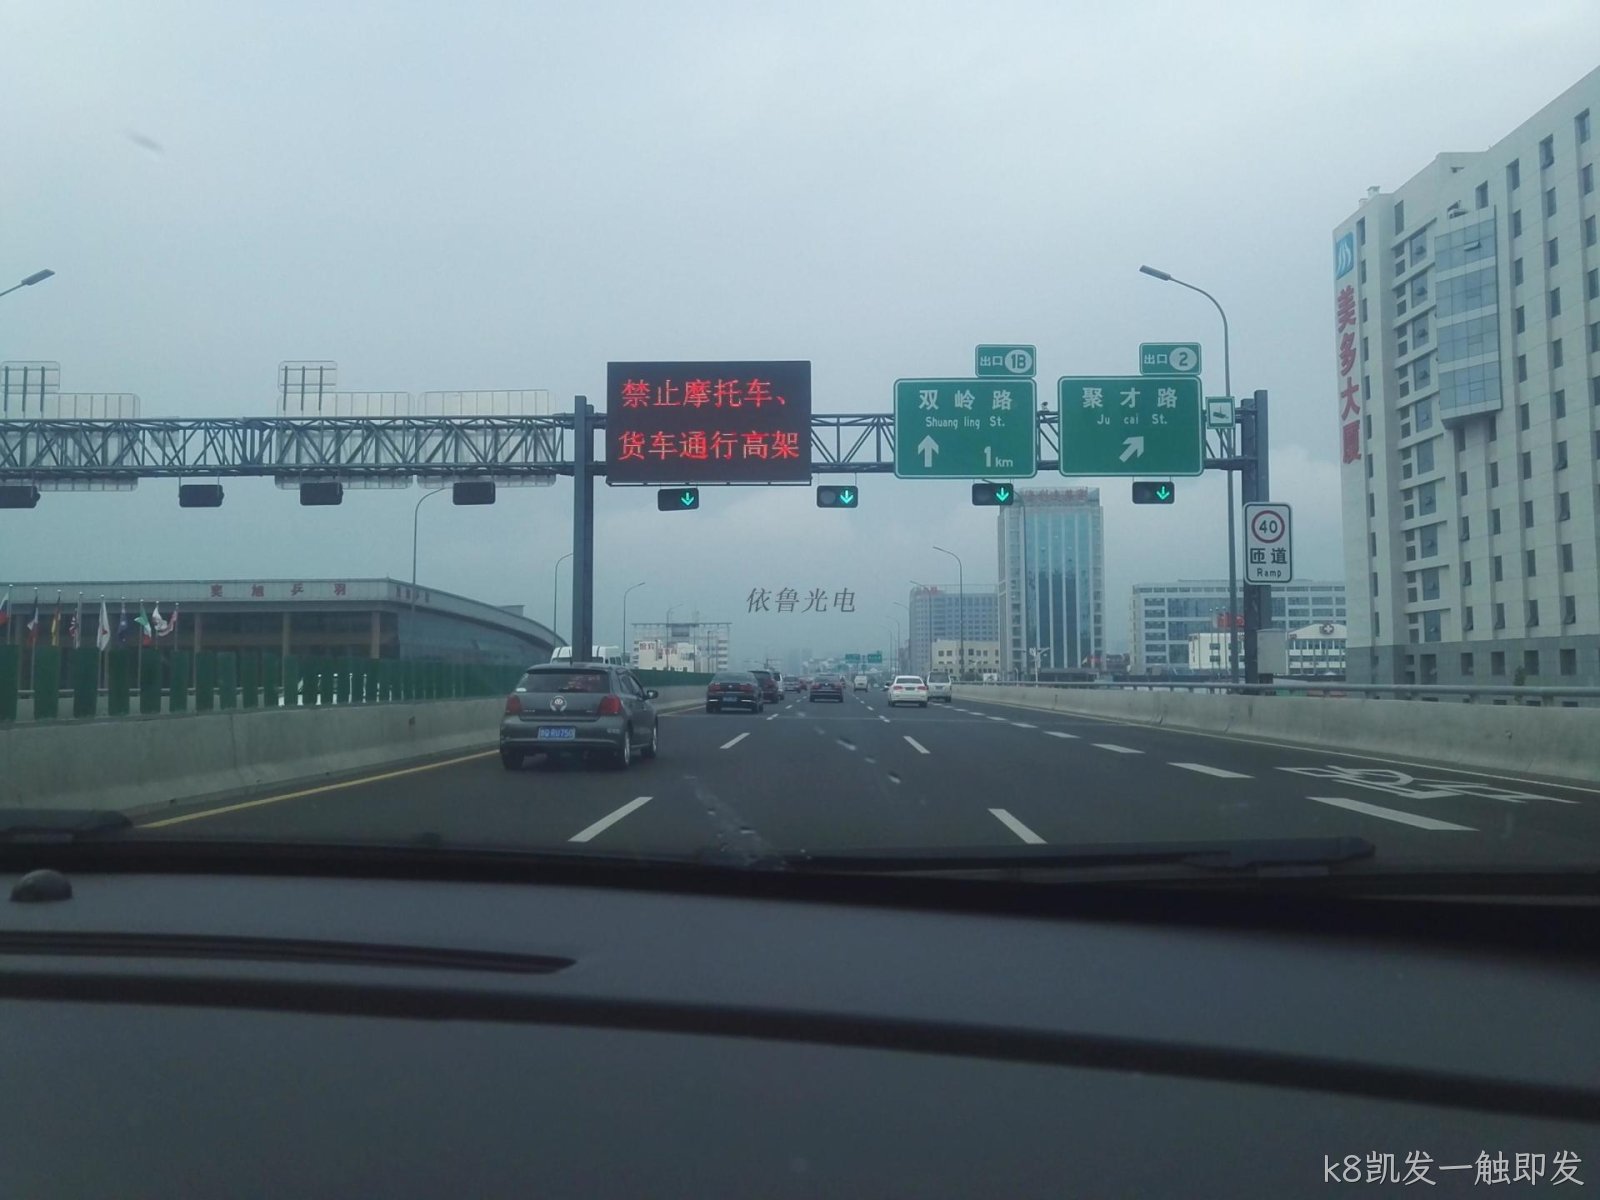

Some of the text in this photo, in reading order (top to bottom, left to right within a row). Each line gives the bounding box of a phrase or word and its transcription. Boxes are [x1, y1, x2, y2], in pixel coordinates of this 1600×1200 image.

[980, 353, 1027, 369] 出口 1B
[1143, 352, 1189, 367] 出口 2
[621, 378, 786, 408] 禁止摩托车、
[918, 389, 1013, 411] 双岭路
[1081, 387, 1178, 409] 聚才路
[925, 416, 1006, 430] Shuang ling St.
[1097, 413, 1168, 425] Ju cai St.
[617, 430, 800, 461] 货车通行高架
[1259, 520, 1278, 534] 40
[1250, 547, 1288, 565] 匝道
[1256, 567, 1282, 578] Ramp
